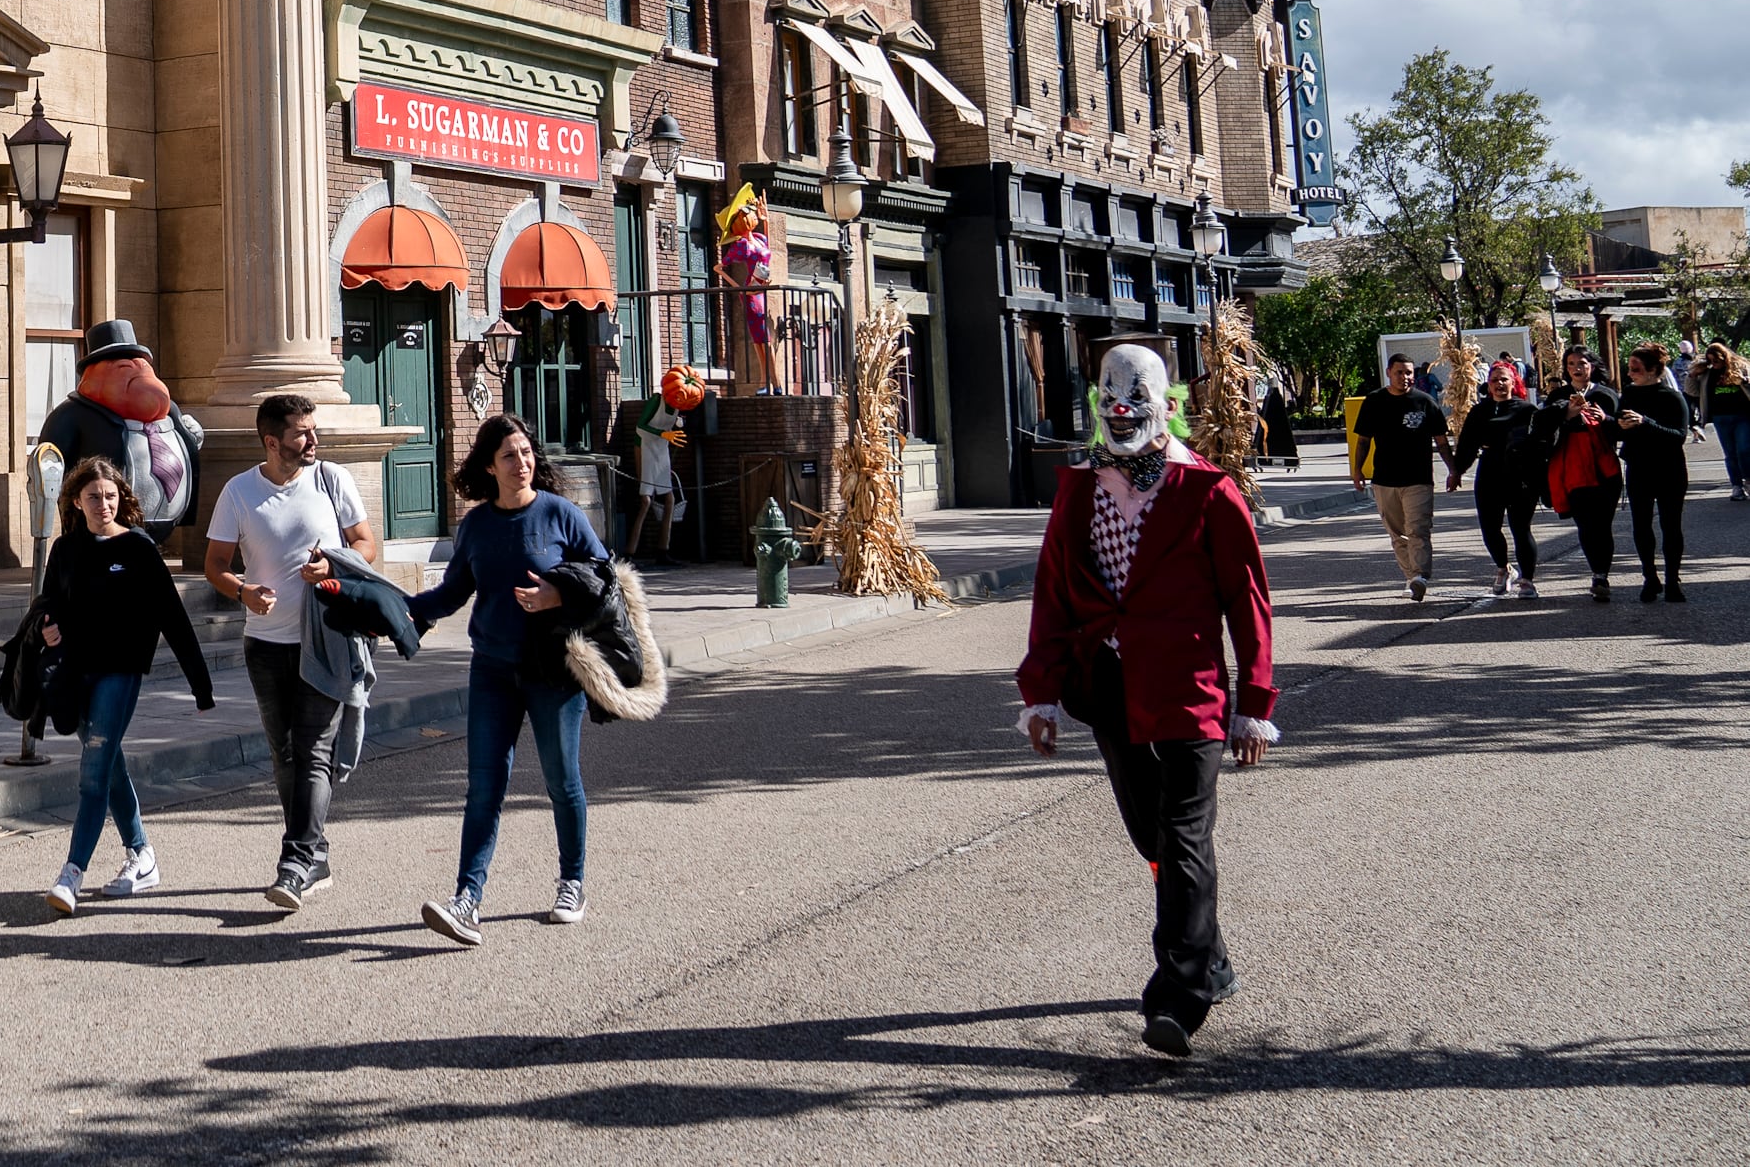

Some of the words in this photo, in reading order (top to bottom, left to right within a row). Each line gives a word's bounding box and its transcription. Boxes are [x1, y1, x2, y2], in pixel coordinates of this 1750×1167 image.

[1298, 18, 1325, 174] SAVOY
[375, 94, 397, 126] L.
[407, 99, 529, 148] SUGARMAN
[537, 123, 550, 151] &
[557, 126, 584, 156] CO
[385, 134, 499, 163] FURNISHINGS
[510, 154, 579, 174] SUPPLIES
[1299, 186, 1342, 200] HOTEL
[658, 219, 676, 252] 51
